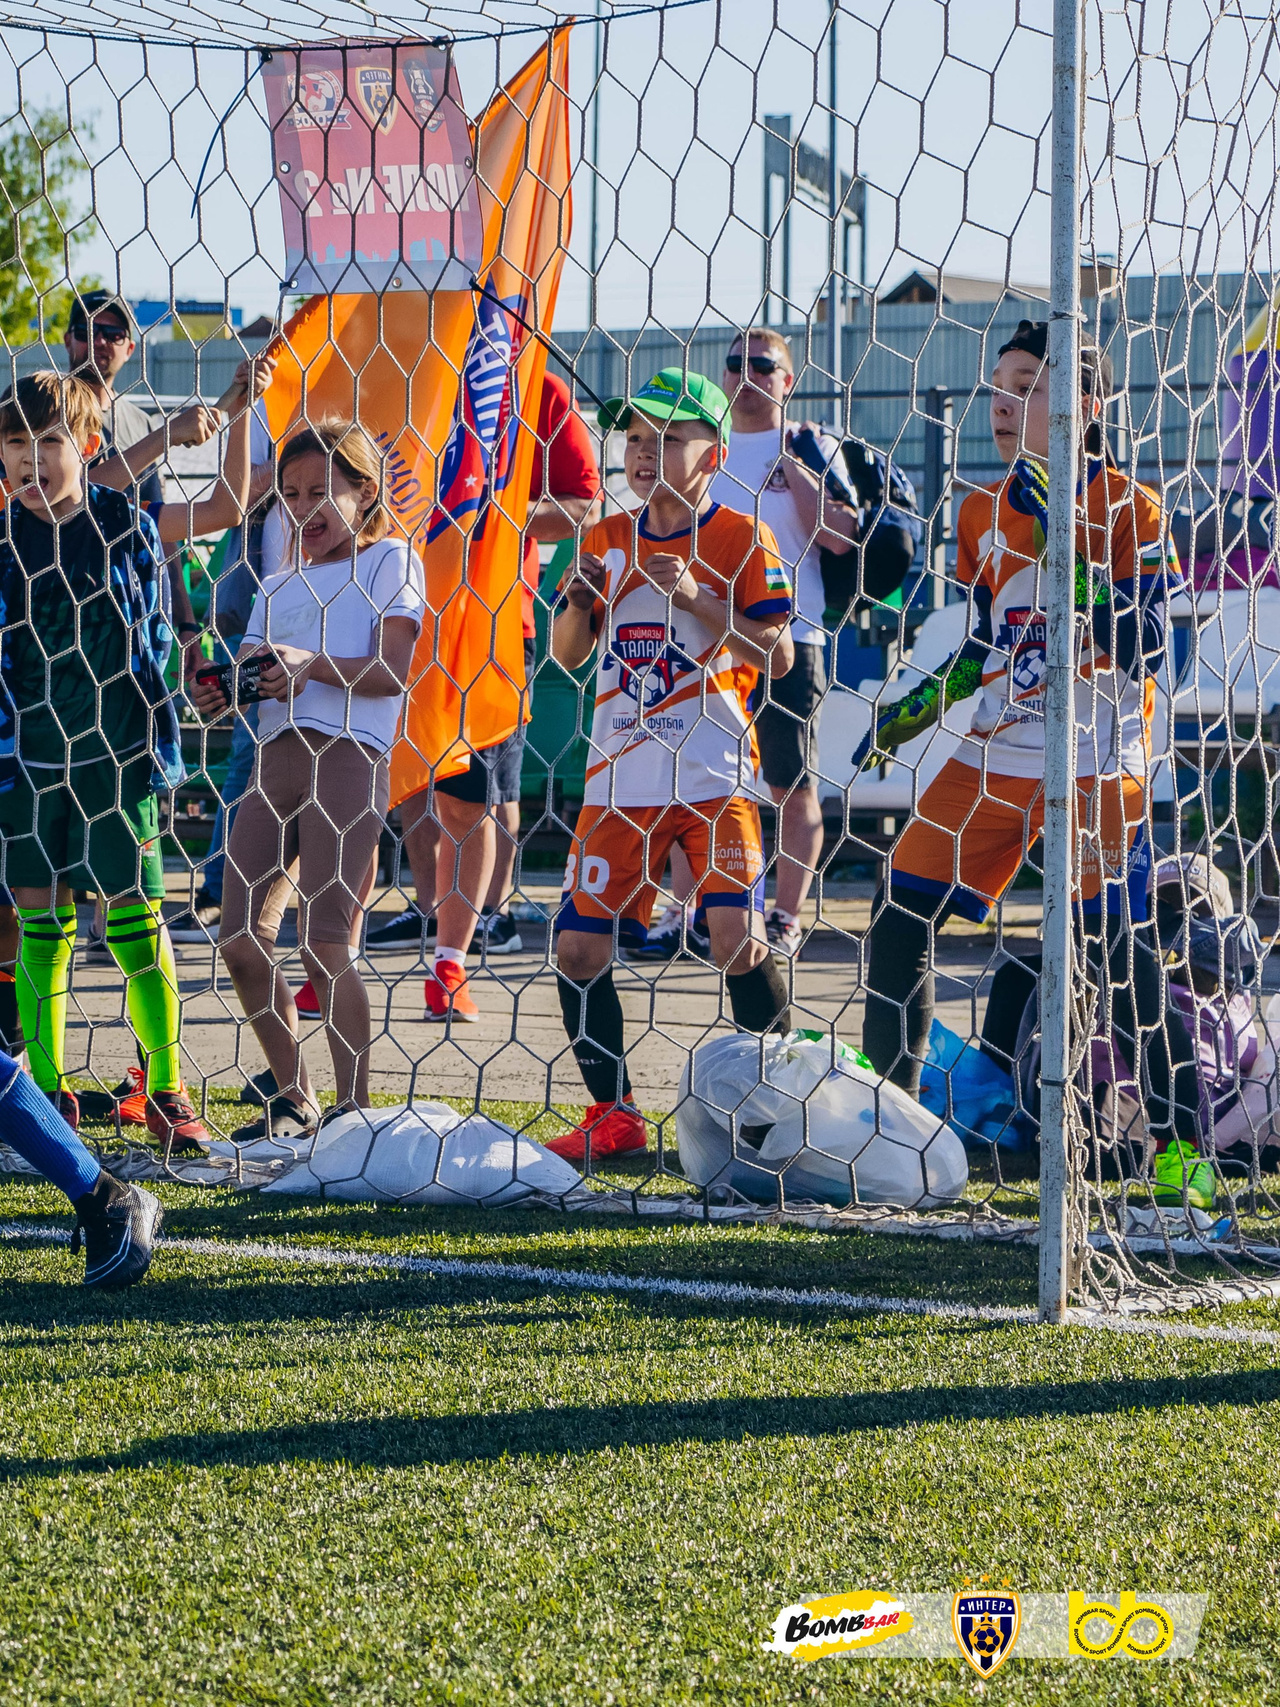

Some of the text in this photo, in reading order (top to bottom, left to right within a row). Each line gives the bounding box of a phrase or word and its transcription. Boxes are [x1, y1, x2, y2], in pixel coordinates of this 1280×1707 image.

[628, 627, 662, 639] ТУЙМАЗЫ
[1009, 625, 1046, 642] ТАЛА
[613, 717, 684, 730] ШКОЛ ФУТБЛА
